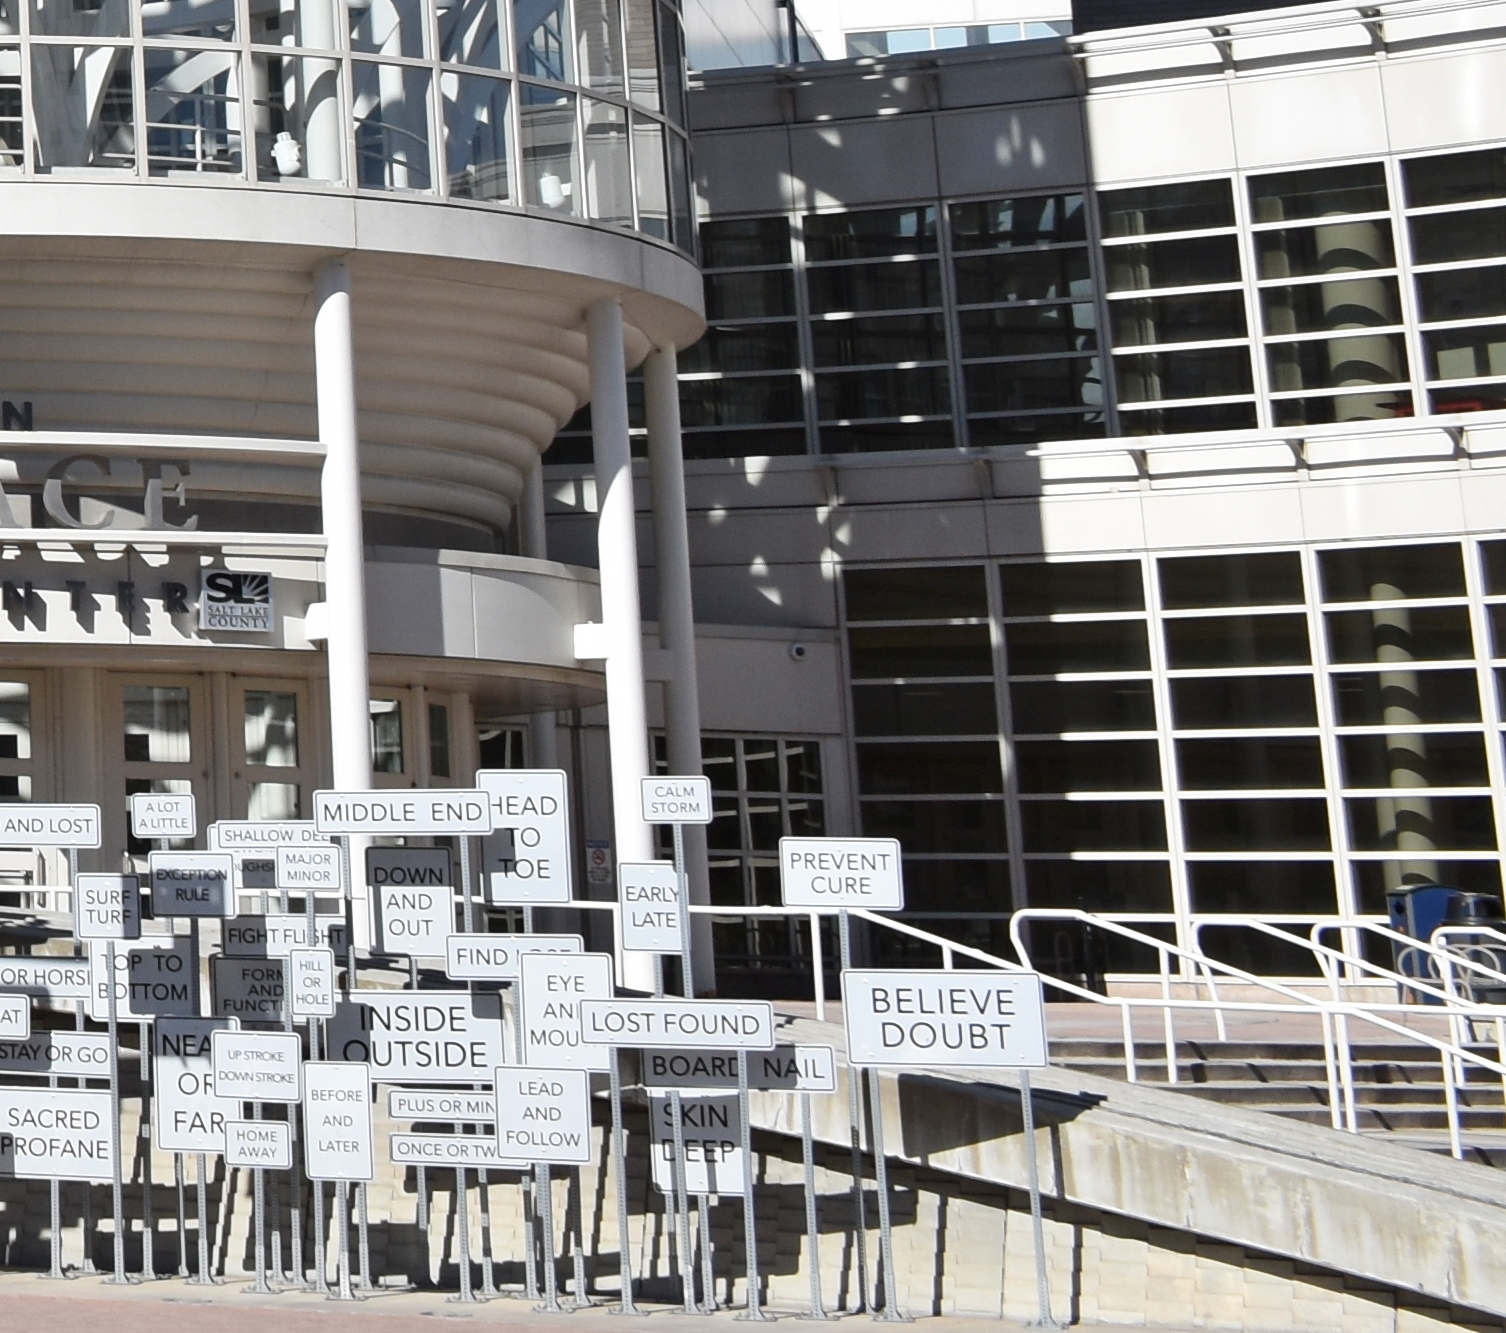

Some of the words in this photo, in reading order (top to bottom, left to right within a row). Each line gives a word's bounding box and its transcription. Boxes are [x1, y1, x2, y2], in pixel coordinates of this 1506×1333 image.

[208, 605, 237, 615] SALT
[241, 607, 269, 616] LAKE
[209, 617, 269, 628] COUNTY
[655, 786, 695, 797] CALM
[324, 803, 415, 821] MIDDLE
[432, 802, 482, 821] END
[651, 802, 700, 813] STORM
[5, 819, 43, 833] AND
[49, 819, 93, 833] LOST
[139, 818, 148, 828] A
[151, 818, 188, 828] LITTLE
[505, 827, 541, 847] TO
[286, 853, 330, 865] MAJOR
[791, 853, 891, 871] PREVENT
[156, 869, 227, 881] EXCEPTION
[287, 870, 330, 881] MINOR
[375, 867, 443, 884] DOWN
[498, 858, 550, 878] TOE
[811, 876, 871, 895] CURE
[86, 889, 131, 904] SURF
[176, 888, 210, 901] RULE
[86, 909, 131, 924] TURF
[632, 912, 676, 928] LATE
[389, 918, 433, 936] OUT
[456, 948, 508, 966] FIND
[546, 975, 585, 992] EYE
[872, 988, 1015, 1015] BELIEVE
[361, 1006, 467, 1031] INSIDE
[592, 1012, 654, 1033] LOST
[664, 1014, 760, 1035] FOUND
[881, 1022, 1011, 1049] DOUBT
[45, 1045, 72, 1060] OR
[77, 1047, 108, 1063] GO
[228, 1051, 242, 1060] UP
[244, 1051, 284, 1062] STROKE
[219, 1071, 254, 1082] DOWN
[256, 1072, 294, 1083] STROKE
[311, 1089, 362, 1102] BEFORE
[519, 1081, 563, 1096] LEAD
[8, 1108, 99, 1129] SACRED
[237, 1131, 277, 1142] HOME
[506, 1131, 581, 1147] FOLLOW
[1, 1136, 108, 1159] PROFANE
[238, 1148, 276, 1159] AWAY
[319, 1141, 359, 1152] LATER
[398, 1142, 442, 1157] ONCE
[447, 1144, 468, 1157] OR
